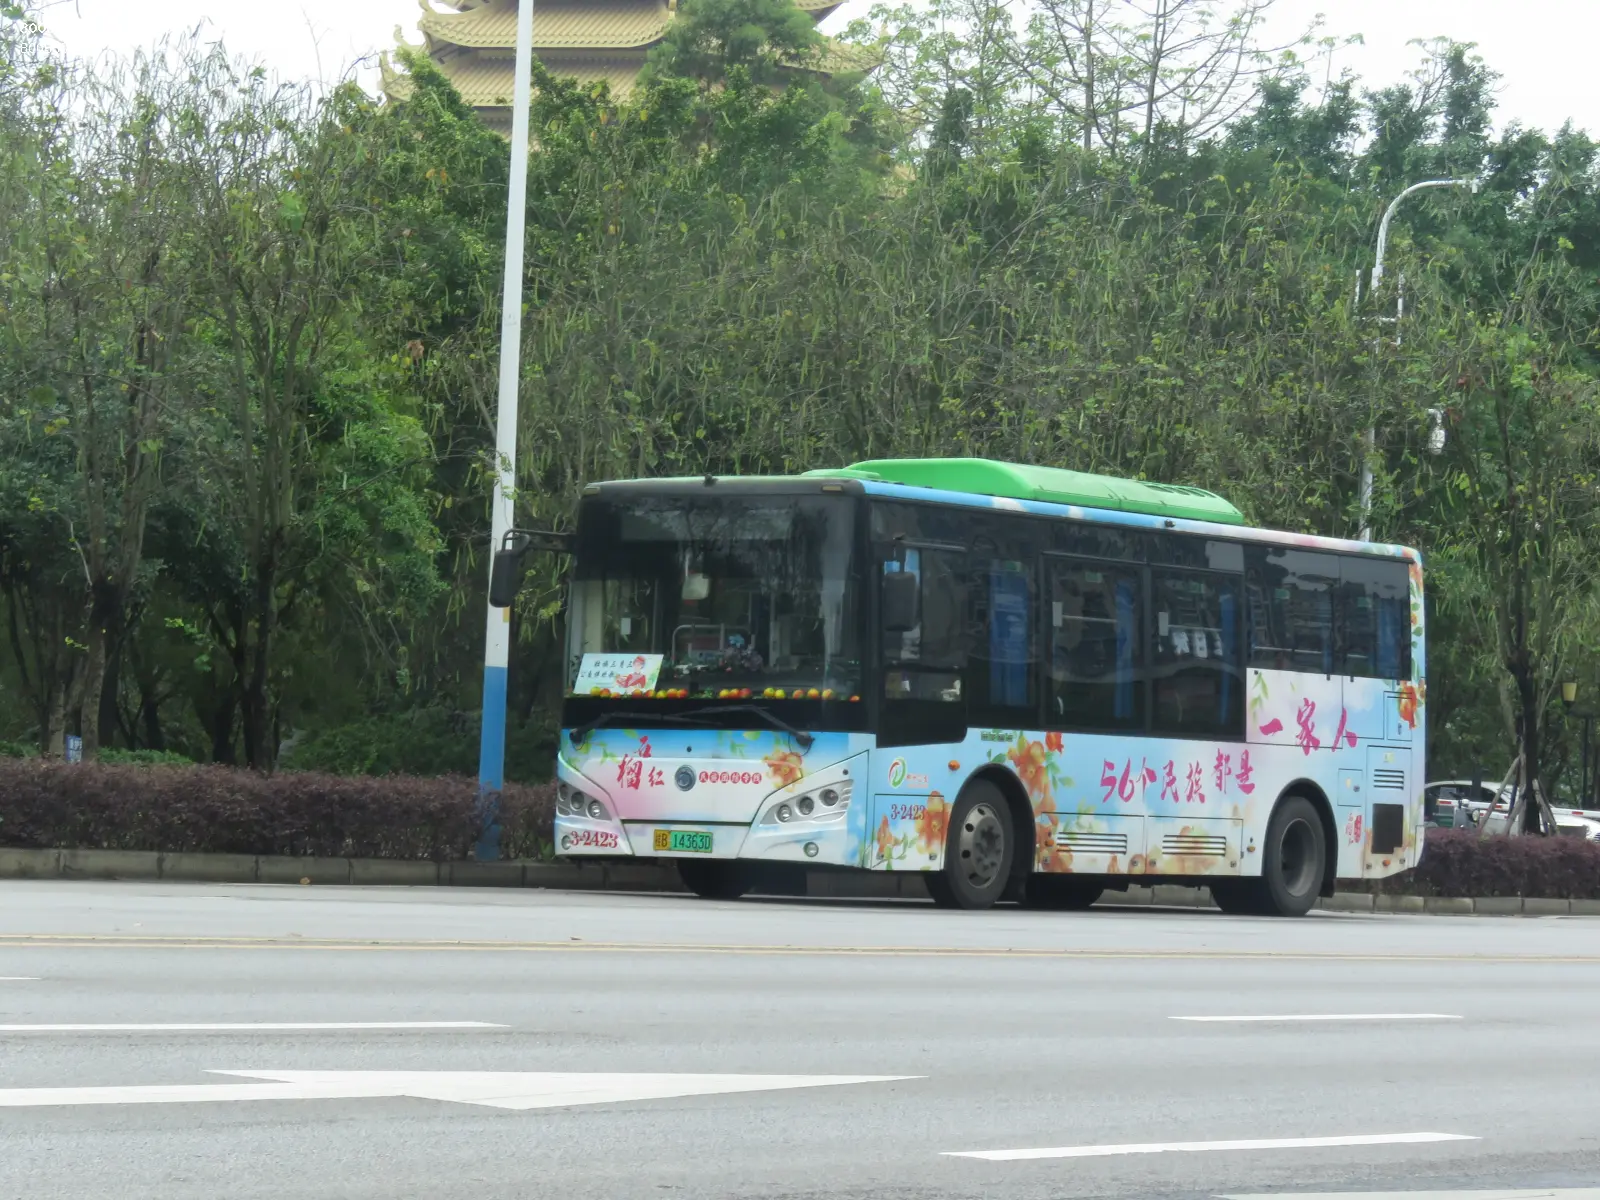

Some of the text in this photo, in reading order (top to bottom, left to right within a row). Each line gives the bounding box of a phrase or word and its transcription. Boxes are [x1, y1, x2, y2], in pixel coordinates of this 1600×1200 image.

[1259, 697, 1358, 756] 一家人
[569, 830, 619, 849] 3-2423
